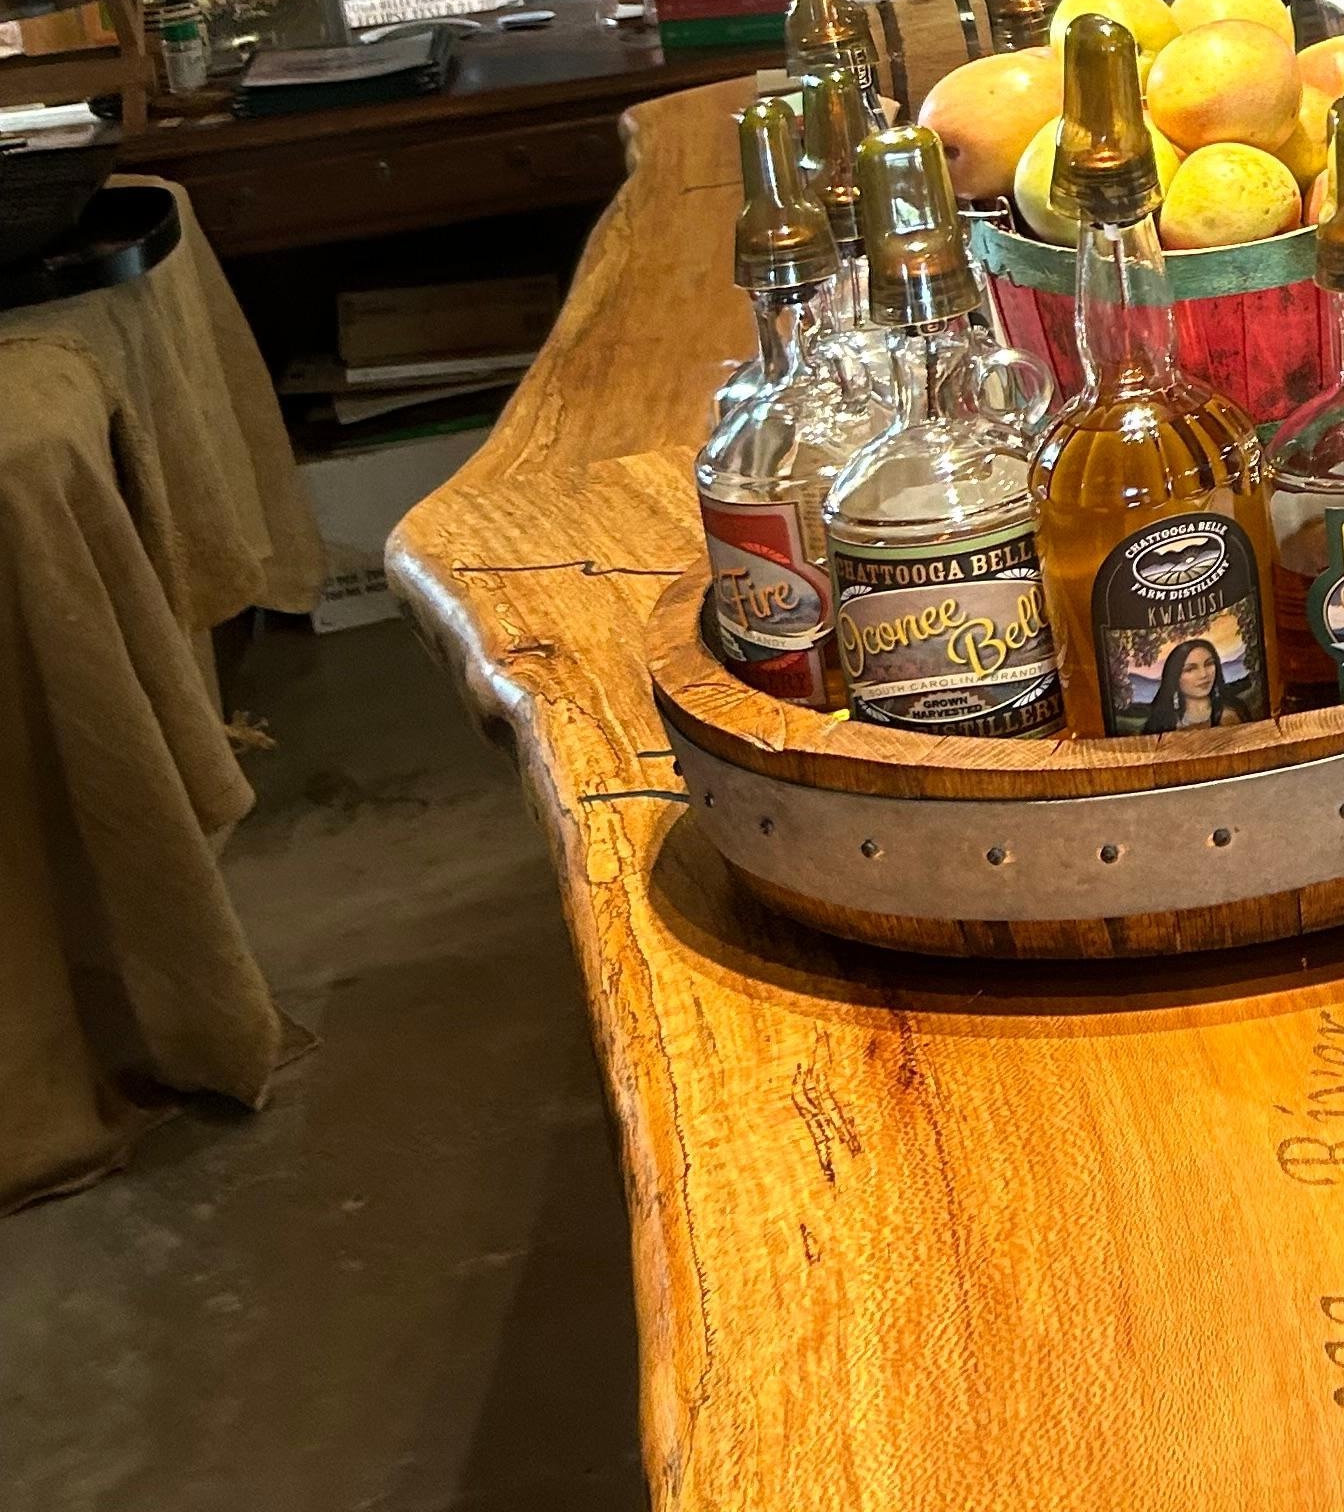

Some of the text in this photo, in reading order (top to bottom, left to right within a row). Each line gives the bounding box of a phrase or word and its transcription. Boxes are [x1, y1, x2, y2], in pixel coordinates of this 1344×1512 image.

[1125, 521, 1228, 559] CHATTOOGA BELLE
[837, 556, 965, 585] CHATTOOGA
[1130, 558, 1230, 600] FARM DISTILLERY
[719, 568, 799, 631] Fire
[1148, 590, 1224, 627] KWALUSI
[840, 599, 966, 677] Oconee
[948, 586, 1048, 676] Bell
[869, 666, 1045, 698] SOUTH CAROLINA BRANDY
[912, 705, 982, 719] HARVESTED
[923, 697, 968, 708] GROWN
[927, 695, 1062, 736] ISTILLERY
